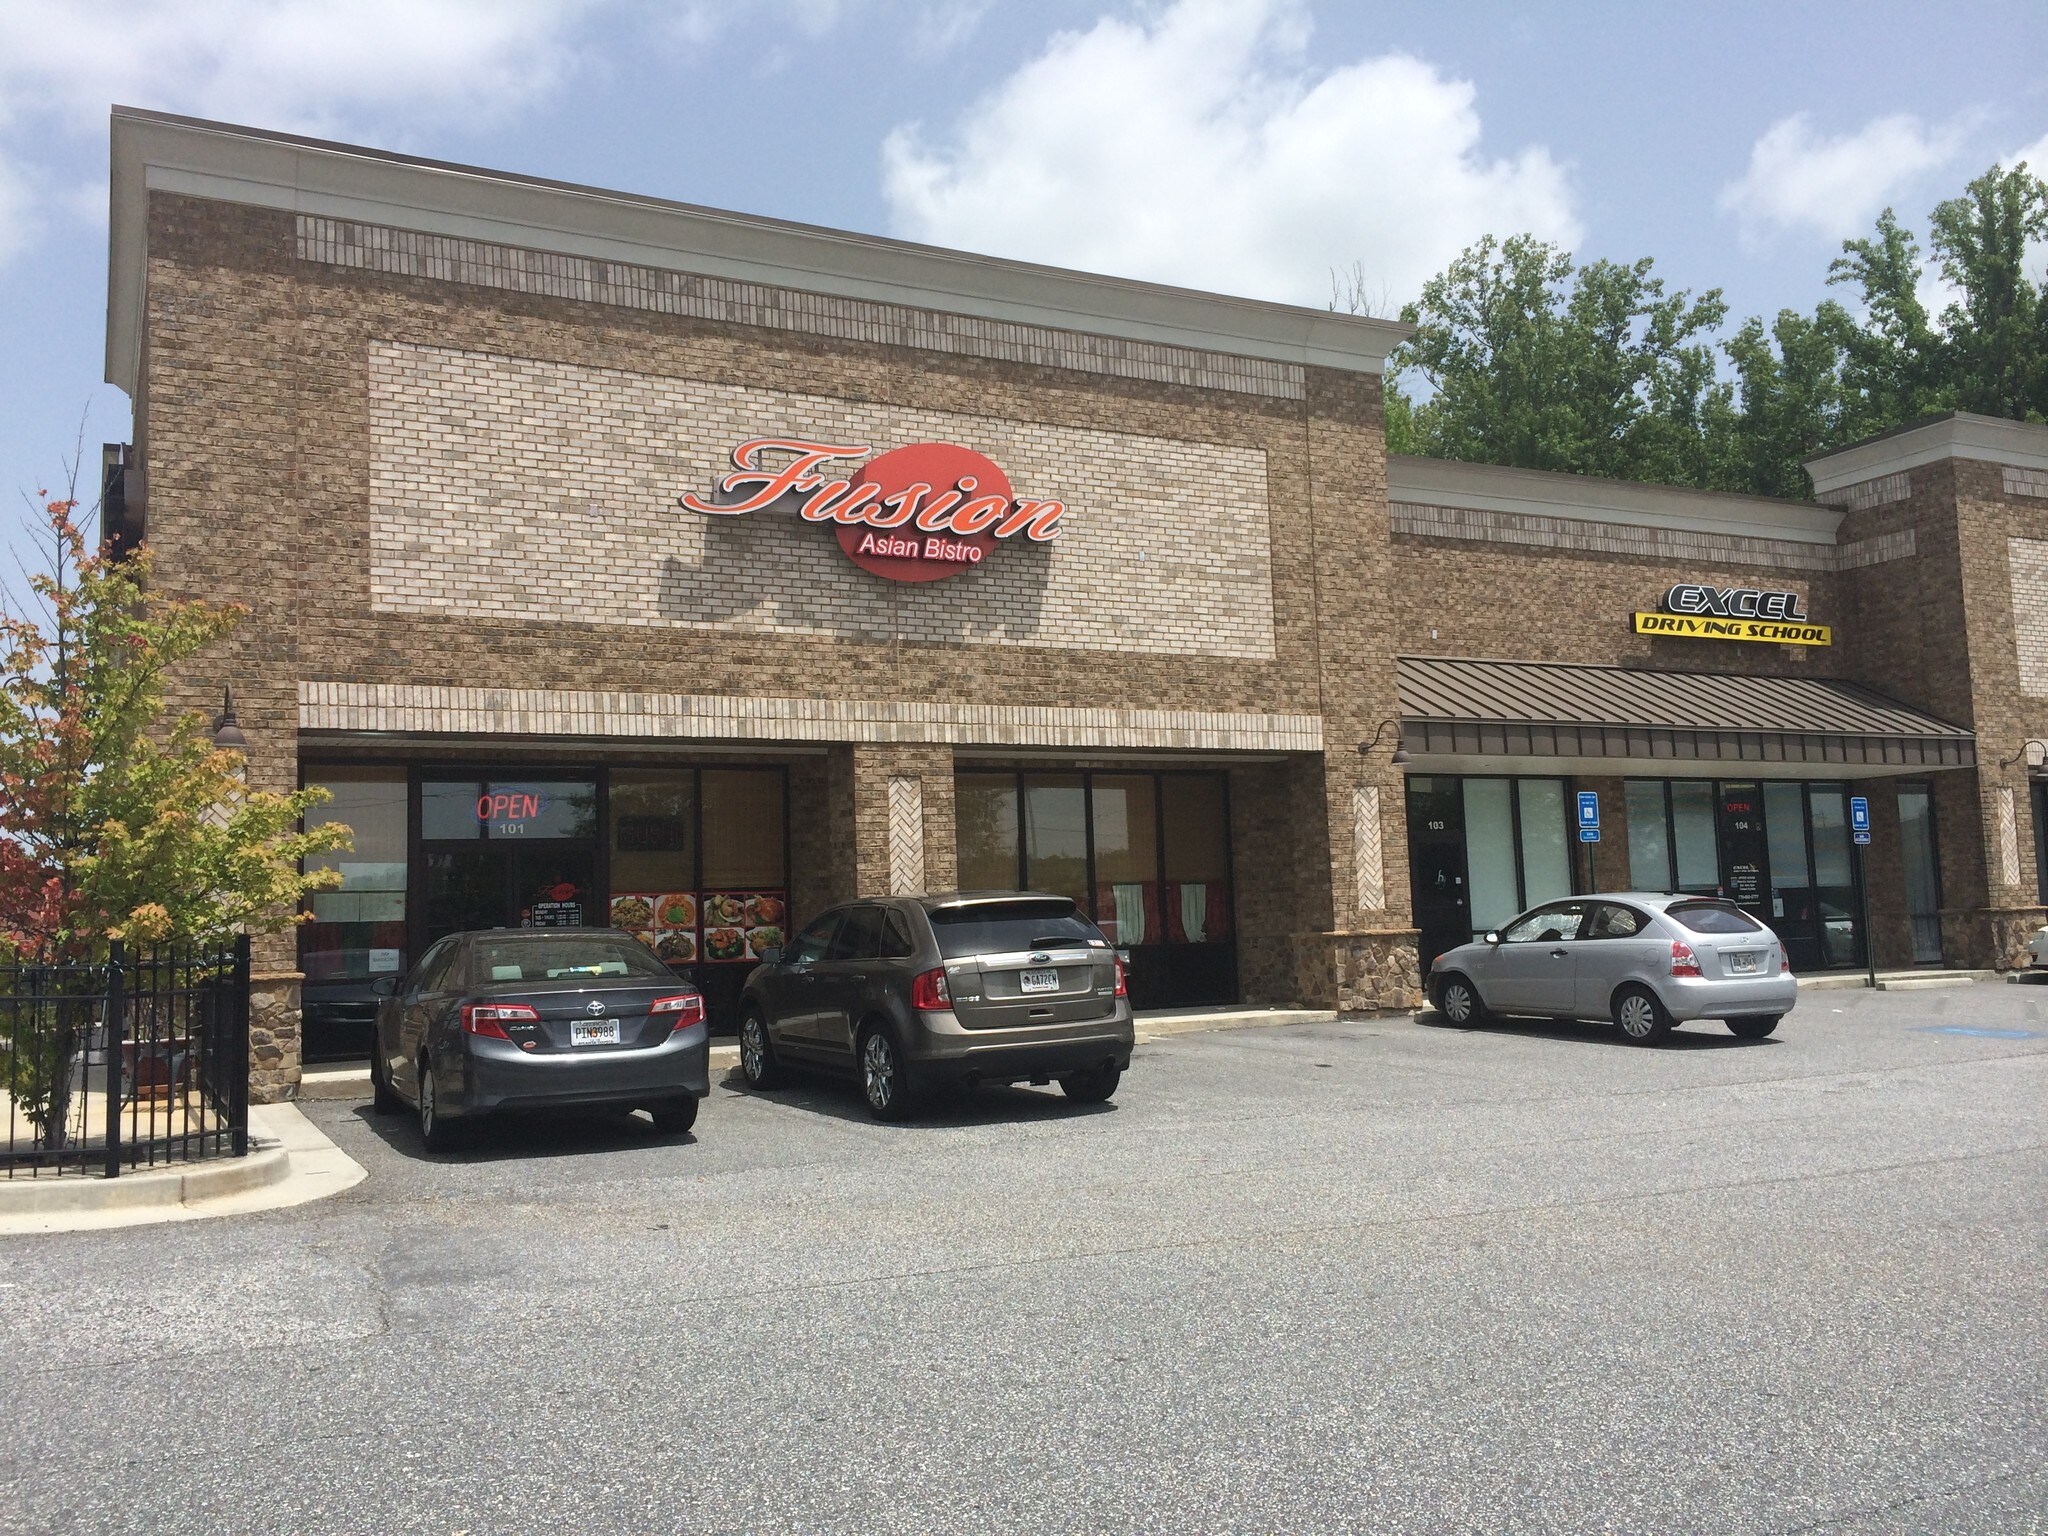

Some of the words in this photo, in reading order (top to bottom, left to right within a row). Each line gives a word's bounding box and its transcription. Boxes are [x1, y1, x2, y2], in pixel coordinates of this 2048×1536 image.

[681, 437, 1067, 542] Fusion
[858, 532, 919, 559] Asian
[923, 538, 983, 564] Bistro
[1667, 583, 1807, 622] EXCEL
[1641, 616, 1742, 636] DRIVING
[1746, 624, 1828, 642] SCHOOL
[476, 793, 539, 820] OPEN
[1727, 803, 1750, 813] OPEN
[499, 823, 524, 835] 101
[1428, 821, 1445, 830] 103
[1735, 821, 1749, 830] 104
[575, 1025, 615, 1039] PIN3988
